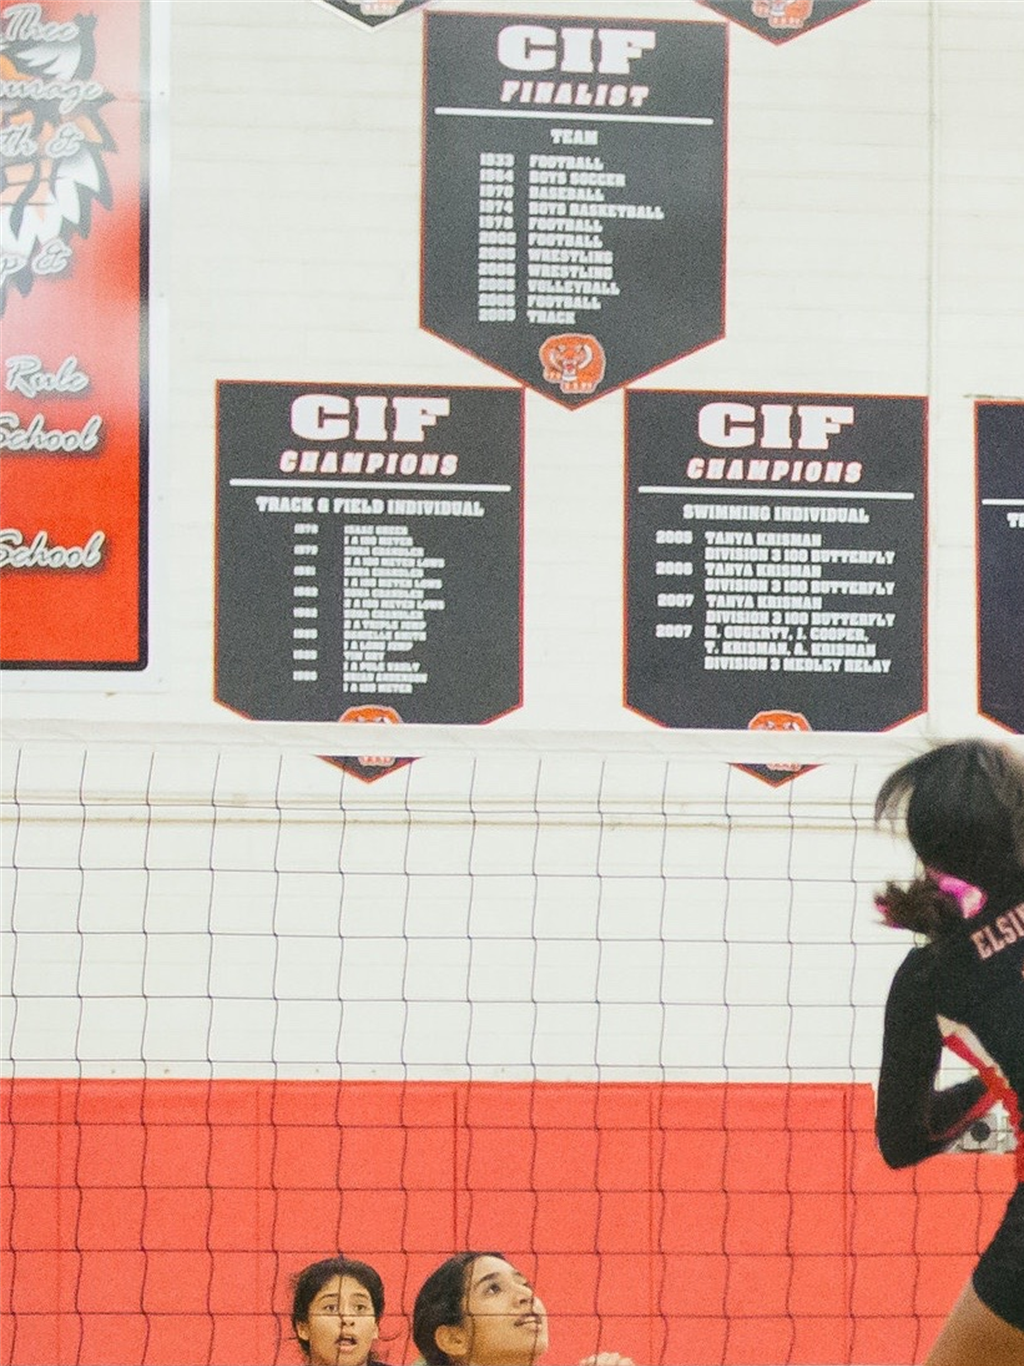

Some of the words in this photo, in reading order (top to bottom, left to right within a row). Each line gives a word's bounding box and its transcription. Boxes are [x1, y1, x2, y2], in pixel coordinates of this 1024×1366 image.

[498, 24, 656, 74] CIF
[501, 80, 649, 107] FINALIST
[551, 129, 598, 146] TEAM
[529, 154, 604, 171] FOOTBALL
[528, 170, 567, 185] BOYS
[570, 172, 626, 188] SOCCER
[528, 186, 605, 202] BASEBALL
[528, 201, 566, 216] BOYS
[569, 203, 664, 220] BASKETBALL
[528, 216, 603, 233] FOOTBALL
[528, 232, 603, 248] FOOTBALL
[527, 248, 614, 265] WRESTLING
[527, 263, 614, 280] WRESTLING
[527, 278, 620, 296] VOLLEYBALL
[527, 294, 602, 310] FOOTBALL
[527, 309, 577, 325] TRACK
[290, 394, 450, 442] CIF
[699, 402, 855, 450] CIF
[279, 450, 459, 476] CHAMPIONS
[686, 458, 863, 484] CHAMPIONS
[256, 496, 314, 512] TRACK
[333, 498, 385, 515] FIELD
[387, 499, 485, 517] INDIVIDUAL
[683, 504, 771, 521] SWIMMING
[773, 506, 870, 524] INDIVIDUAL
